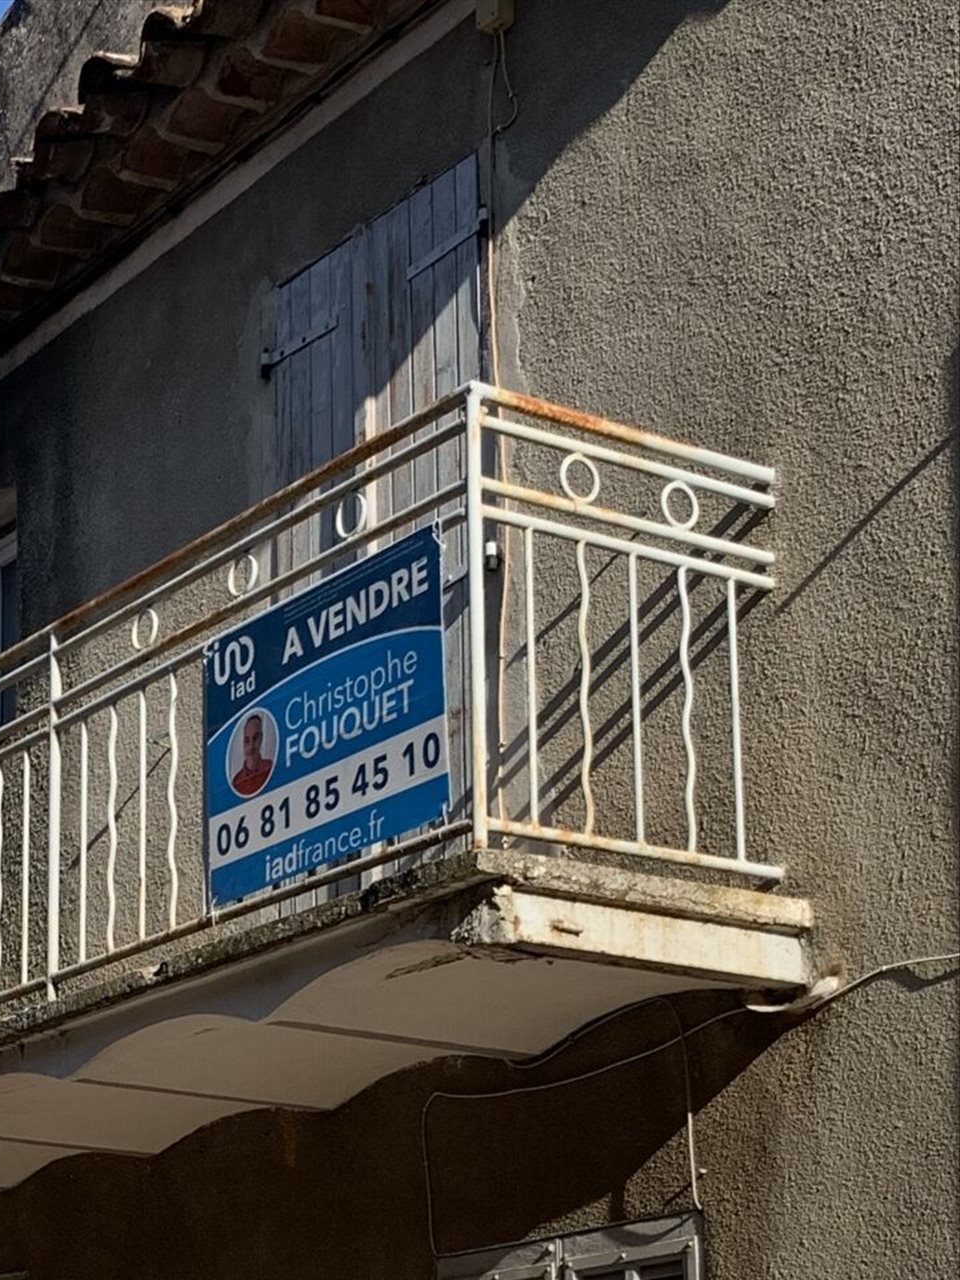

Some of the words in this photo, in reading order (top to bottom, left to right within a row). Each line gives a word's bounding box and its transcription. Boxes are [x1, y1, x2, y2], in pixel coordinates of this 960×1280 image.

[282, 626, 304, 666] A
[307, 559, 430, 648] VENDRE
[230, 670, 256, 701] iad
[285, 649, 418, 730] Christophe
[285, 679, 415, 768] FOUQUET
[217, 815, 249, 856] 06
[260, 796, 291, 838] 81
[305, 775, 340, 819] 85
[351, 753, 389, 797] 45
[402, 731, 441, 777] 10
[264, 809, 386, 883] iadfrance.fr
